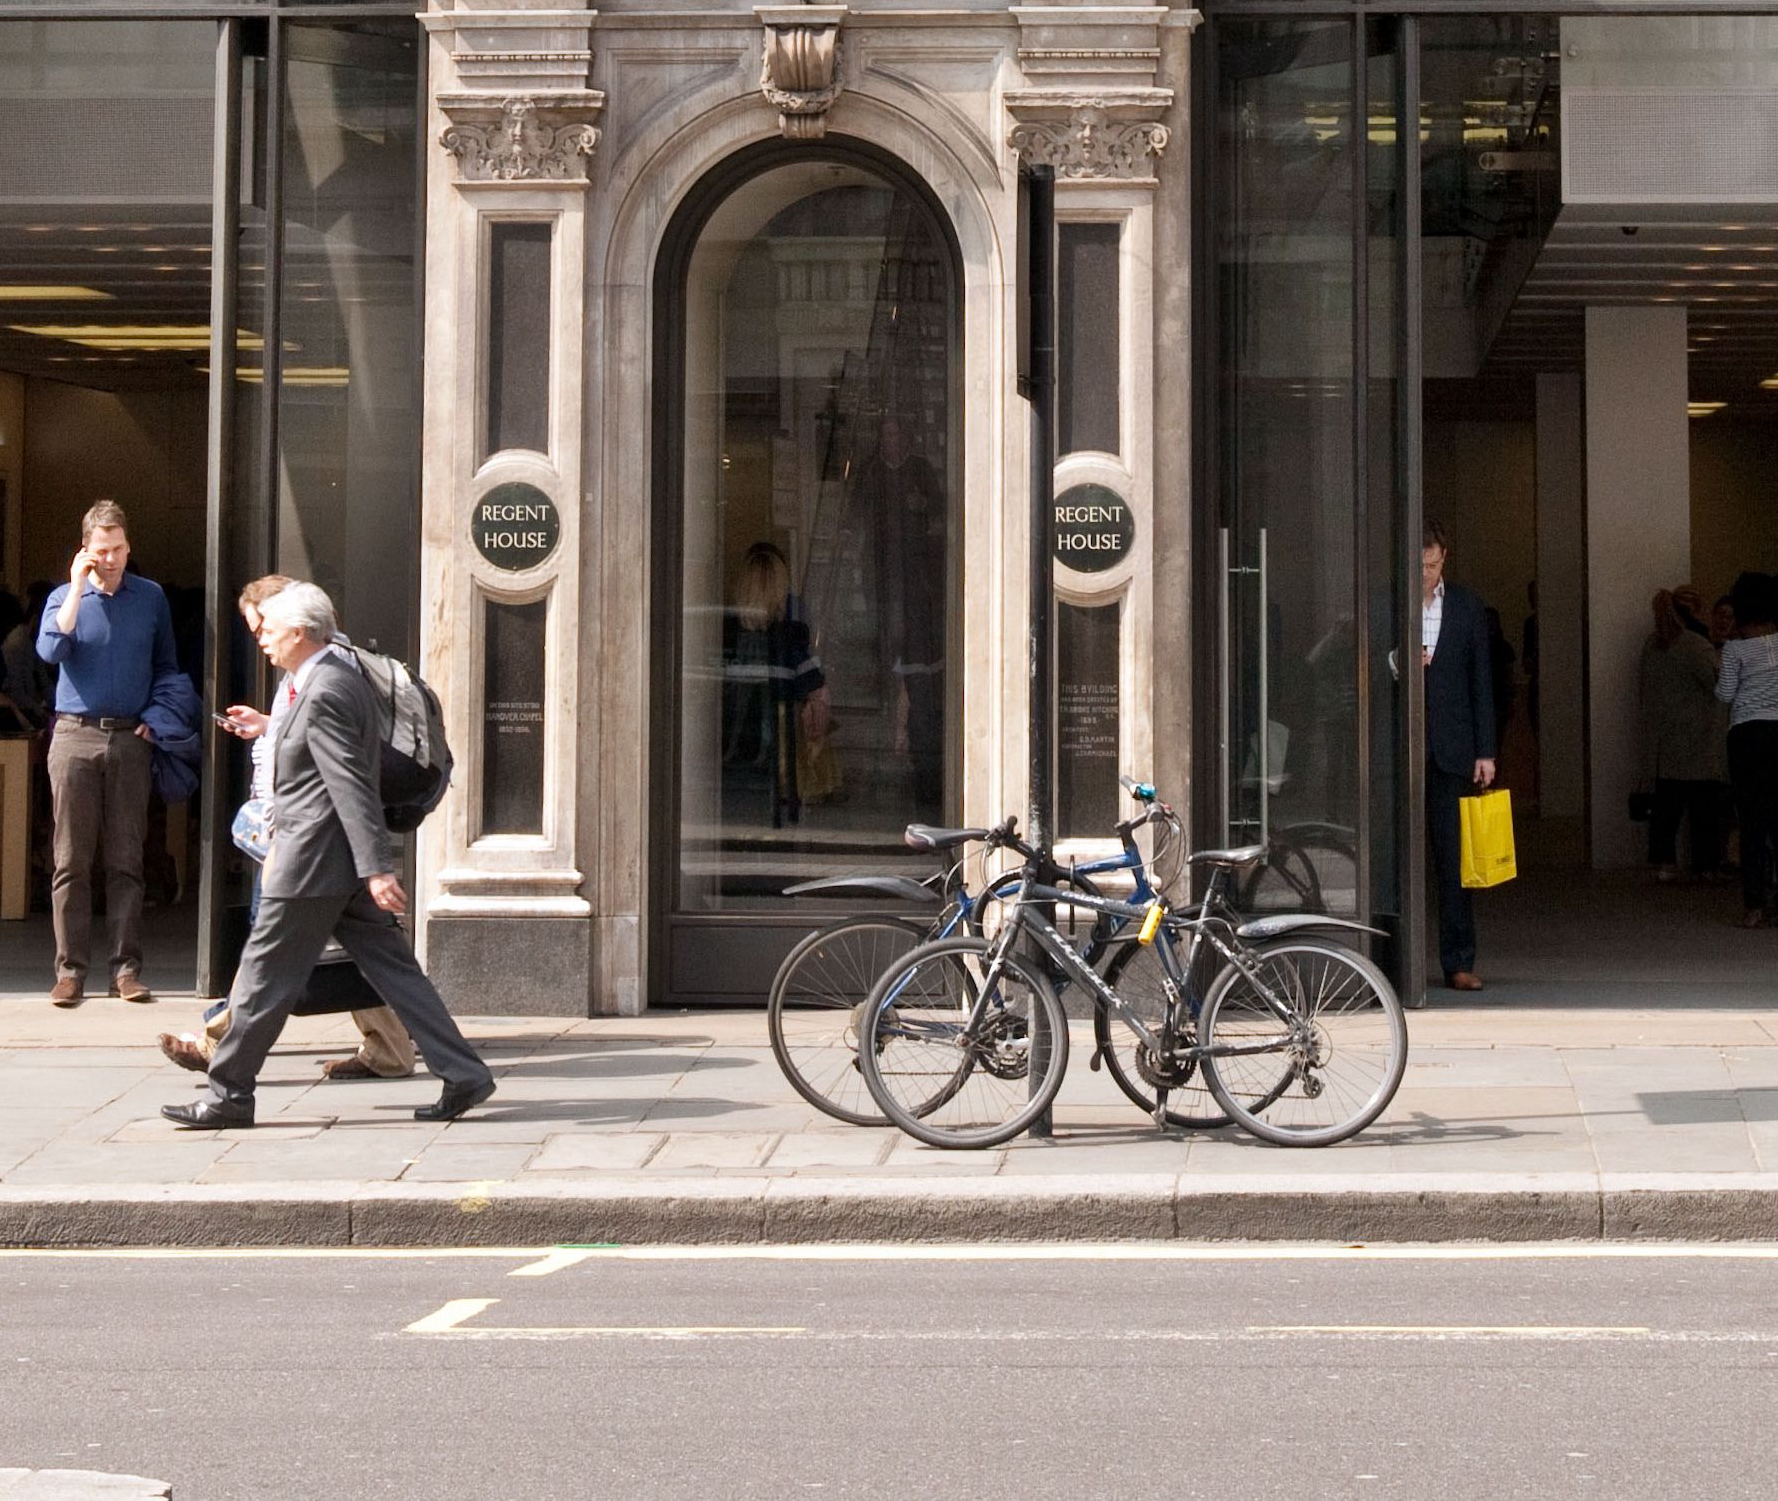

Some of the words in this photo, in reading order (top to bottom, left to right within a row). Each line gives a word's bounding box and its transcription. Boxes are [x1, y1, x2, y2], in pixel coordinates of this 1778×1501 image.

[482, 505, 550, 521] REGENT
[1055, 506, 1123, 523] REGENT
[484, 532, 547, 548] HOUSE
[1058, 533, 1121, 550] HOUSE
